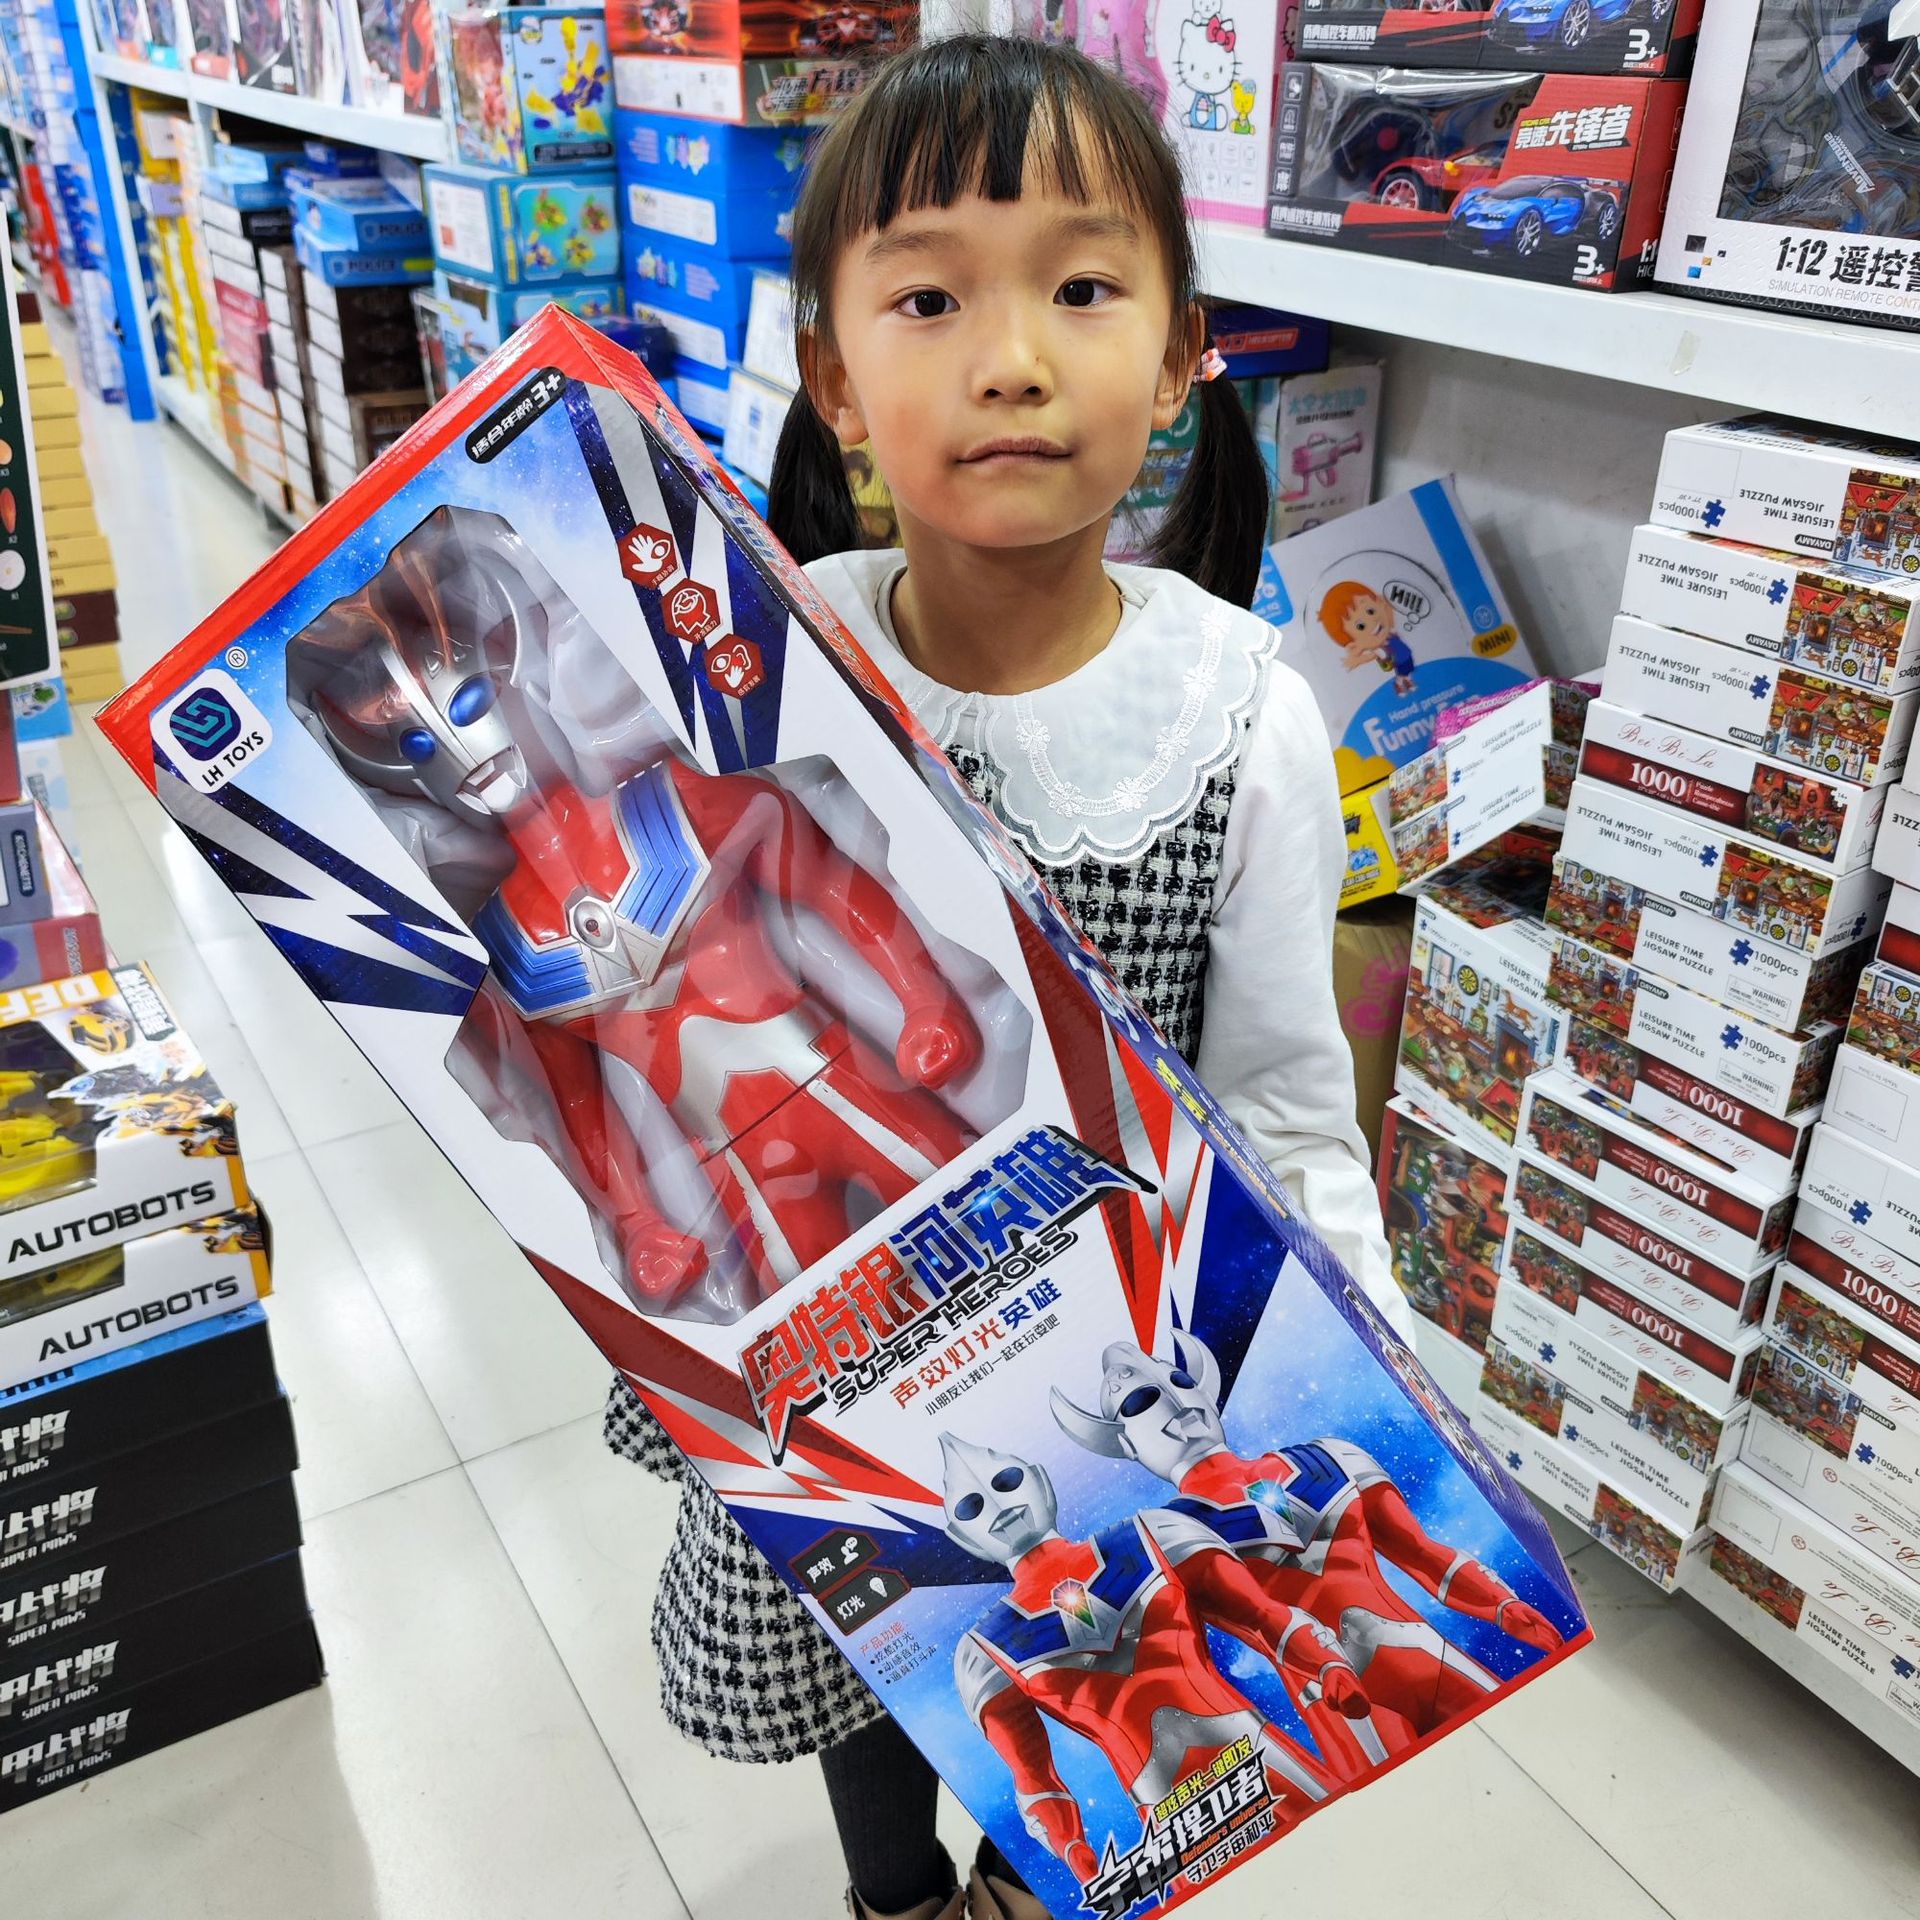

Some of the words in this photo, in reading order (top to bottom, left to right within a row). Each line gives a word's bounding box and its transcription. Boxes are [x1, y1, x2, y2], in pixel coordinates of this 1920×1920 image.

[1624, 29, 1658, 61] 3+
[1573, 245, 1605, 276] 3+
[1776, 237, 1828, 276] 1:12
[1768, 279, 1832, 298] SIMULATION
[1835, 288, 1882, 304] REMOTE
[471, 397, 534, 459] 适合年龄
[530, 373, 561, 408] 3+
[1739, 488, 1779, 504] PUZZLE
[1779, 499, 1825, 513] JIGSAW
[1659, 501, 1700, 520] 1000pcs
[1763, 507, 1788, 520] TIME
[1791, 512, 1835, 528] LEISURE
[1796, 534, 1832, 550] DAYAMY
[1638, 553, 1675, 571] PUZZLE
[1678, 564, 1718, 582] JIGSAW
[1660, 574, 1684, 588] TIME
[1687, 581, 1728, 600] LEISURE
[1729, 577, 1766, 596] 1000pcs
[1478, 630, 1511, 653] MINI
[1747, 634, 1780, 651] DAYAMY
[1619, 645, 1657, 663] PUZZLE
[1641, 666, 1667, 681] TIME
[1659, 657, 1701, 676] JIGSAW
[1668, 672, 1710, 693] LEISURE
[1712, 671, 1750, 690] 1000pcs
[1388, 701, 1419, 723] Hand
[1422, 683, 1466, 712] pressure
[1731, 728, 1763, 745] DAYAMY
[202, 765, 224, 787] LH
[223, 731, 264, 768] TOYS
[1629, 761, 1687, 799] 1000
[1577, 805, 1613, 827] PUZZLE
[1597, 827, 1622, 844] TIME
[1615, 821, 1654, 841] JIGSAW
[1622, 835, 1662, 858] LEISURE
[1663, 836, 1700, 858] 1000pcs
[1645, 899, 1676, 917] DAYAMY
[1681, 890, 1713, 911] DAYAMY
[1645, 929, 1681, 951] LEISURE
[1682, 945, 1704, 960] TIME
[1642, 941, 1677, 963] JIGSAW
[1679, 957, 1714, 976] PUZZLE
[1754, 950, 1798, 977] 1000pcs
[1639, 979, 1669, 999] DAYAMY
[1752, 988, 1788, 1009] WARNING:
[1639, 1009, 1675, 1032] LEISURE
[1675, 1026, 1696, 1043] TIME
[1637, 1020, 1671, 1042] JIGSAW
[1672, 1037, 1705, 1058] PUZZLE
[1744, 1036, 1786, 1064] 1000pcs
[1689, 1086, 1744, 1126] 1000
[1654, 1166, 1710, 1207] 1000
[1808, 1184, 1847, 1212] 1000pcs
[8, 1180, 216, 1264] AUTOBOTS
[1639, 1236, 1694, 1277] 1000
[742, 1129, 1130, 1446] 奥特银河英雄
[1840, 1268, 1899, 1315] 1000
[39, 1275, 239, 1362] AUTOBOTS
[833, 1316, 946, 1416] SUPER
[943, 1226, 1080, 1331] HEROES
[1631, 1307, 1685, 1348] 1000
[890, 1277, 1063, 1410] 声效灯光英雄
[1568, 1340, 1598, 1362] PUZZLE
[1577, 1355, 1595, 1370] TIME
[1599, 1359, 1630, 1383] JIGSAW
[1596, 1368, 1628, 1392] LEISURE
[1863, 1406, 1895, 1431] DAYAMY
[1541, 1464, 1559, 1480] TIME
[1611, 1440, 1647, 1468] LEISURE
[1647, 1464, 1670, 1483] TIME
[1876, 1455, 1914, 1484] 1000pcs
[1560, 1478, 1589, 1502] LEISURE
[1619, 1457, 1654, 1485] JIGSAW
[1655, 1481, 1691, 1509] PUZZLE
[806, 1557, 836, 1583] 声效
[836, 1595, 866, 1621] 灯光
[1808, 1611, 1842, 1640] LEISURE
[1844, 1637, 1867, 1658] TIME
[1805, 1620, 1840, 1647] JIGSAW
[1841, 1646, 1875, 1675] PUZZLE
[22, 1697, 61, 1720] SUPER
[36, 1763, 74, 1787] SUPER
[1154, 1735, 1253, 1822] 超炫声光一键即发
[1181, 1824, 1228, 1867] Defenders
[1229, 1795, 1269, 1831] universe
[1187, 1809, 1276, 1882] 守卫宇宙和平
